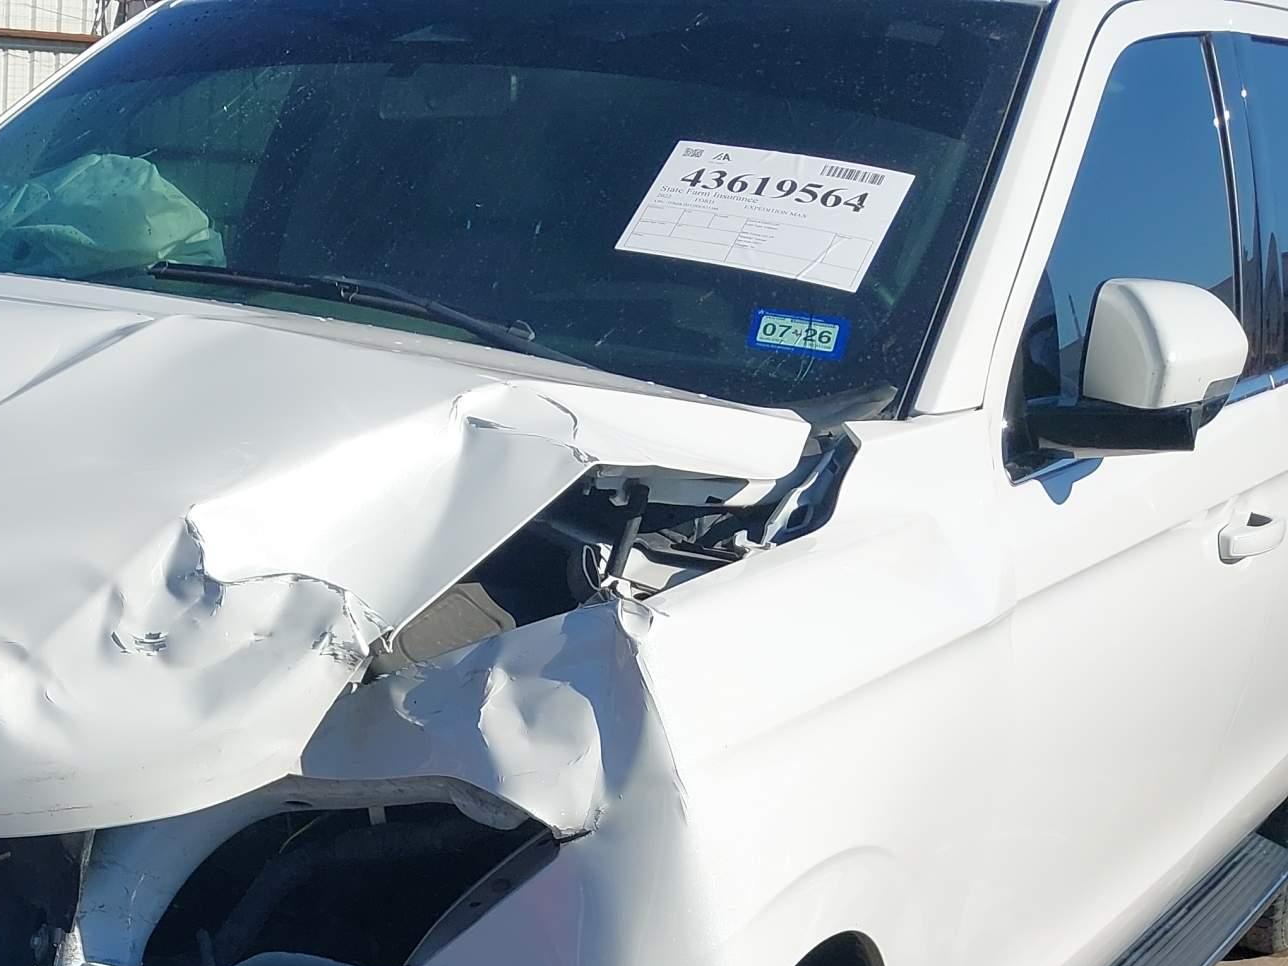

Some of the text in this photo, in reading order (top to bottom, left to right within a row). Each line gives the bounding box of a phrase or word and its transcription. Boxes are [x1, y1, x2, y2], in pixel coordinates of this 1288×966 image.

[660, 185, 759, 204] State Farm Insurance
[681, 167, 871, 213] 43619564
[762, 322, 793, 338] 07
[803, 327, 833, 344] 26
